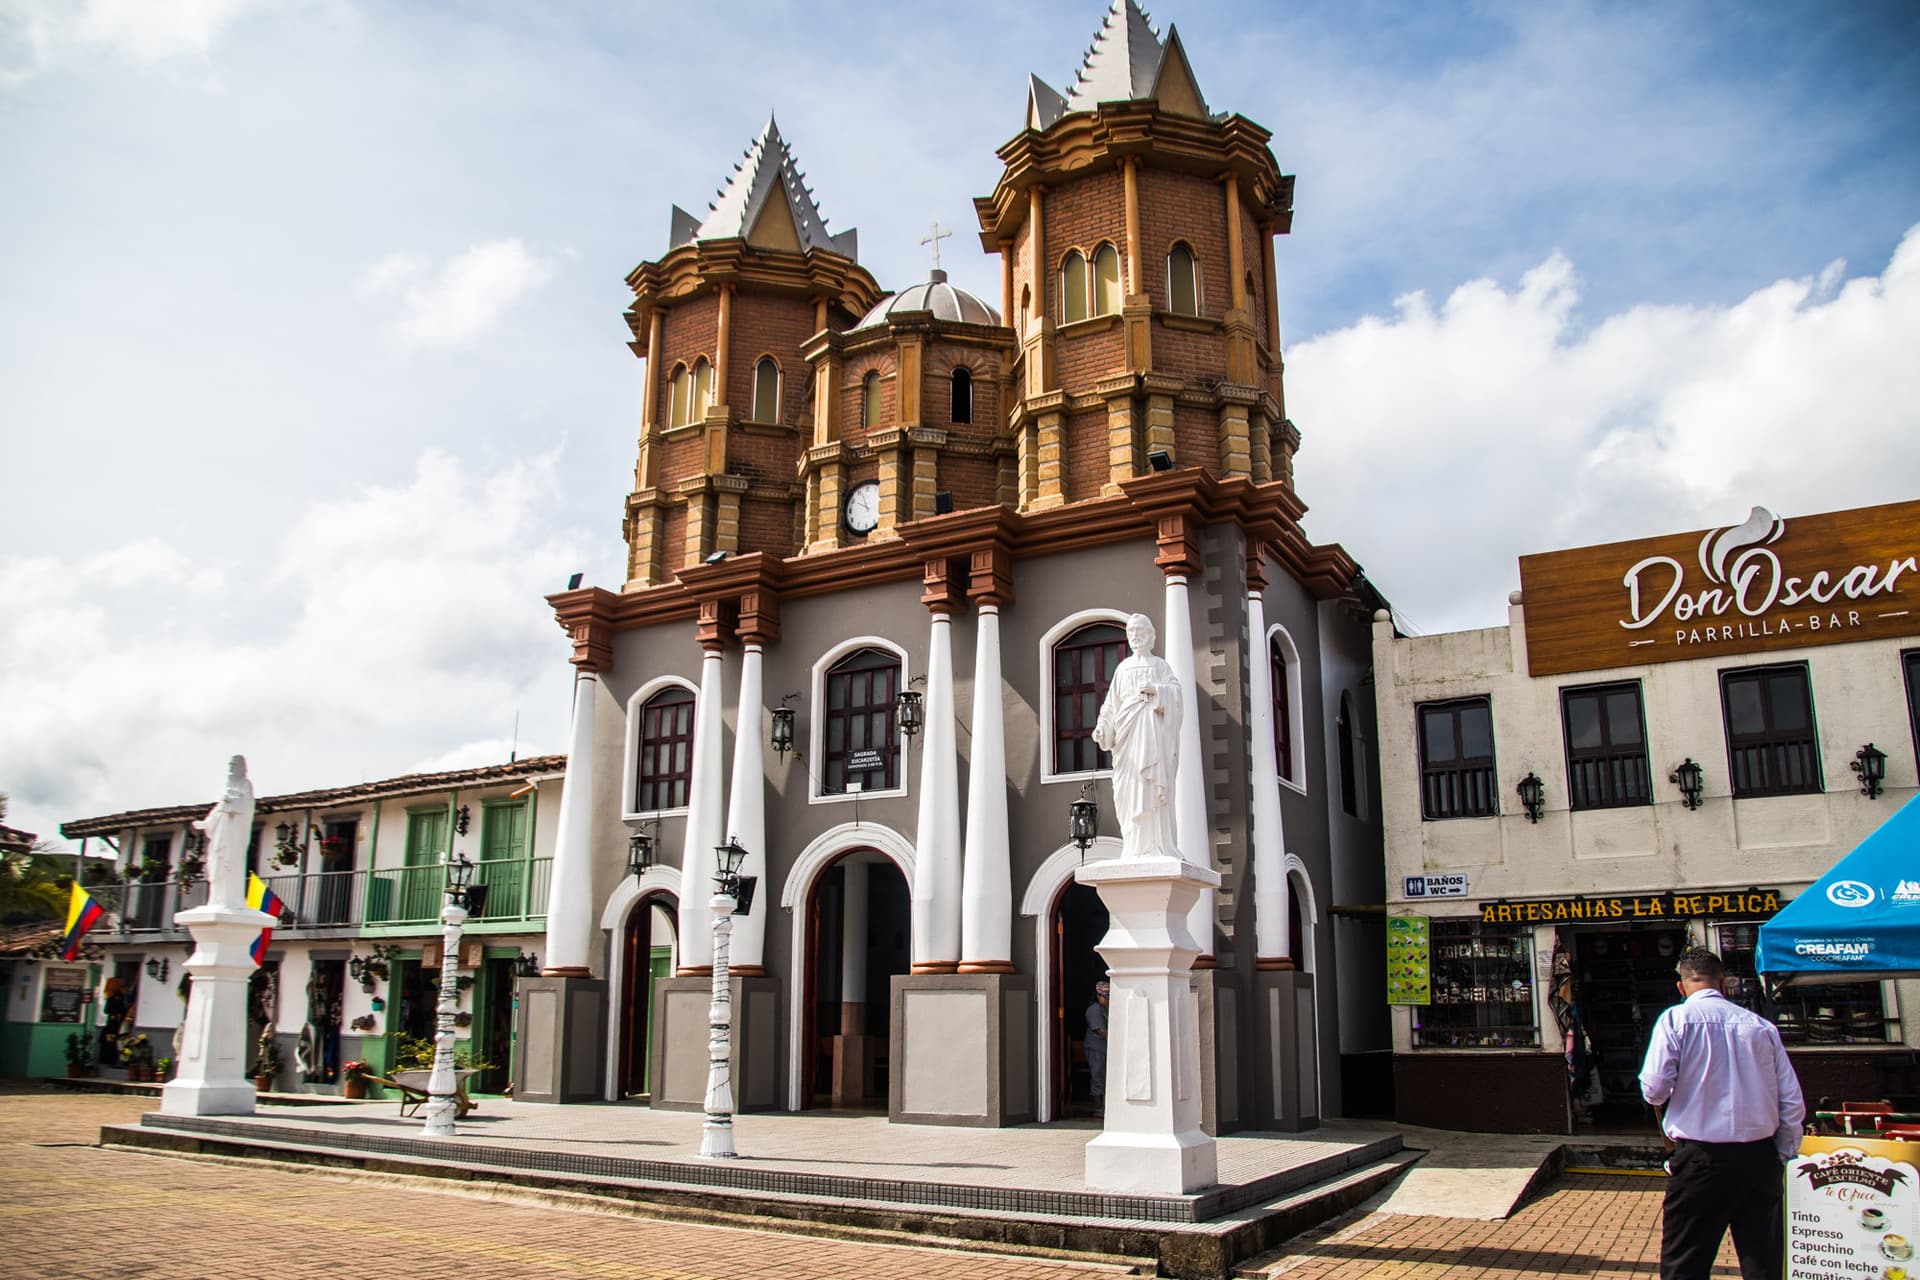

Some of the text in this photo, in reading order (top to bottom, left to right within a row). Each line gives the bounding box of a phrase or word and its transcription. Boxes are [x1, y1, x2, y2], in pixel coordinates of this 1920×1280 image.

[1619, 548, 1918, 629] Don Oscar
[1676, 610, 1861, 645] PARRILLA-BAR
[1426, 875, 1463, 886] BAÑOS
[1430, 887, 1447, 895] WC
[1482, 893, 1780, 923] ARTESANIAS LA REPLICA
[1813, 1167, 1889, 1186] CAFÉ ORIENTE
[1827, 1174, 1876, 1187] EXCELSO
[1791, 1211, 1821, 1223] Tinto
[1791, 1226, 1844, 1239] Expresso
[1791, 1240, 1854, 1255] Capuchino
[1791, 1254, 1879, 1274] Café con leche
